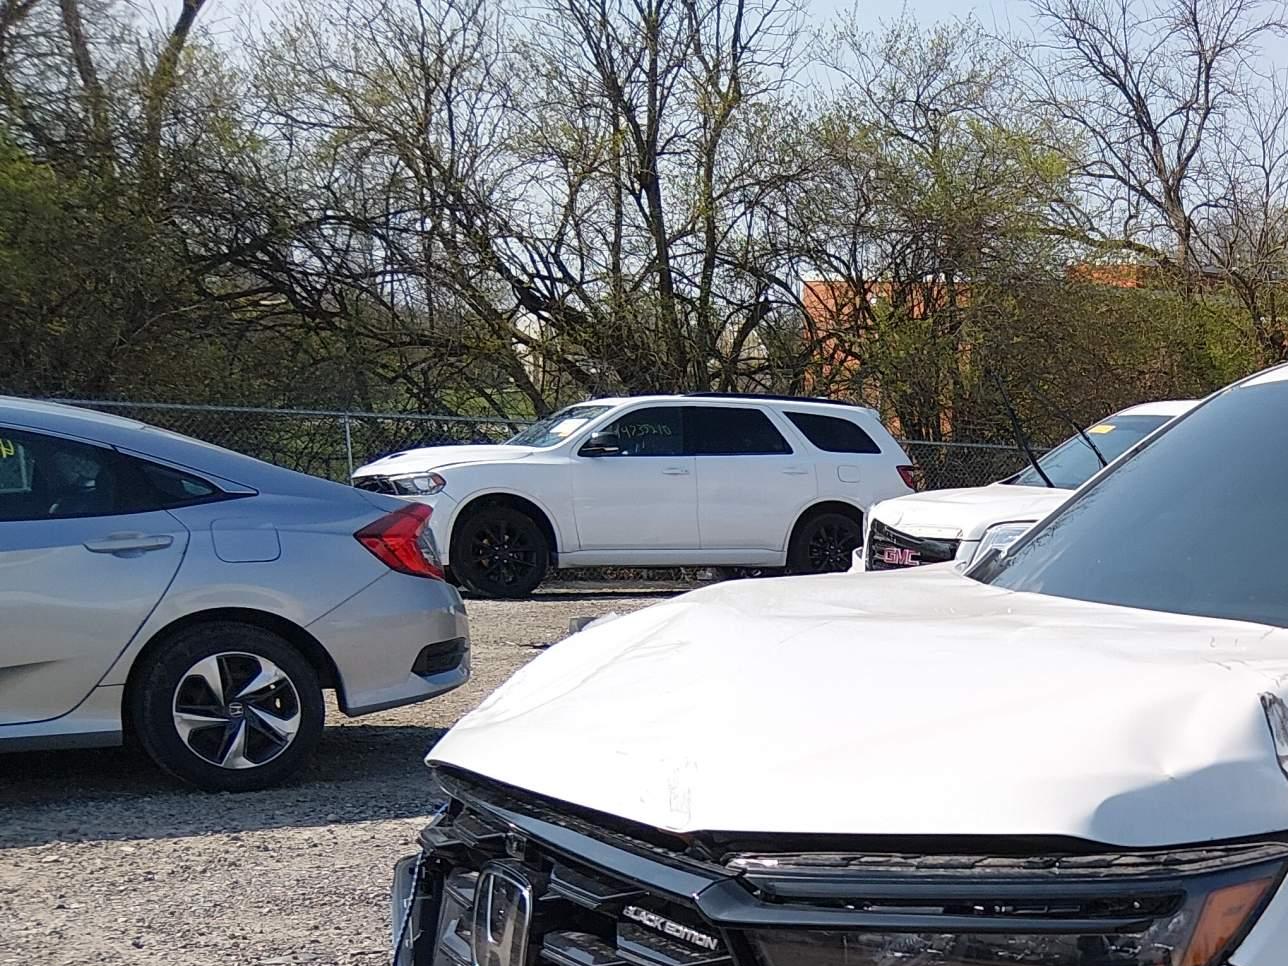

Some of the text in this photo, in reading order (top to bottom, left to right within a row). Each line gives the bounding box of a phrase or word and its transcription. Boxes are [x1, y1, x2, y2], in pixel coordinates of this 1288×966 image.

[884, 547, 921, 566] GMC
[623, 905, 718, 950] BLACK EDITION
